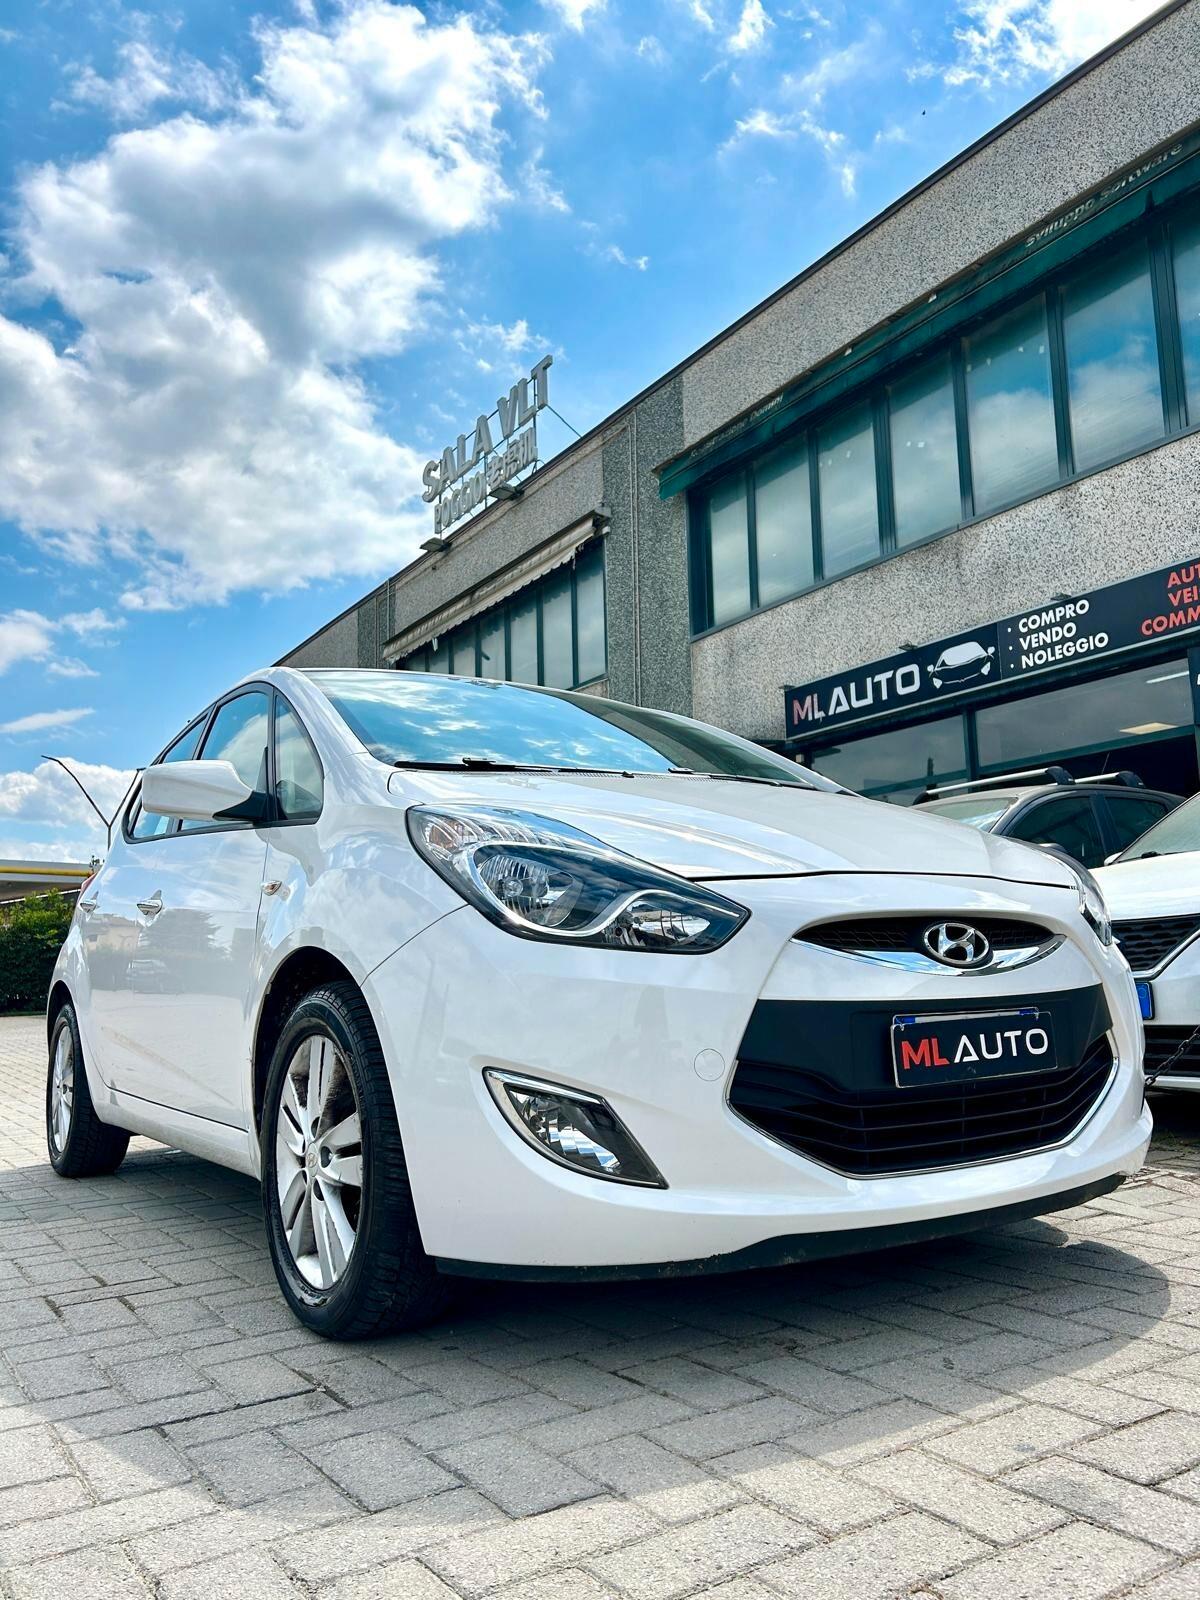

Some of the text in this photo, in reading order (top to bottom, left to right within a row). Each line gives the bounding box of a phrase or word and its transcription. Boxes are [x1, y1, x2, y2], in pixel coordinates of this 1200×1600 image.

[421, 354, 554, 503] SALA VLT
[1018, 599, 1090, 633] COMPRO
[1019, 622, 1077, 651] VENDO
[1021, 632, 1109, 669] NOLEGGIO
[953, 1028, 1049, 1064] AUTO
